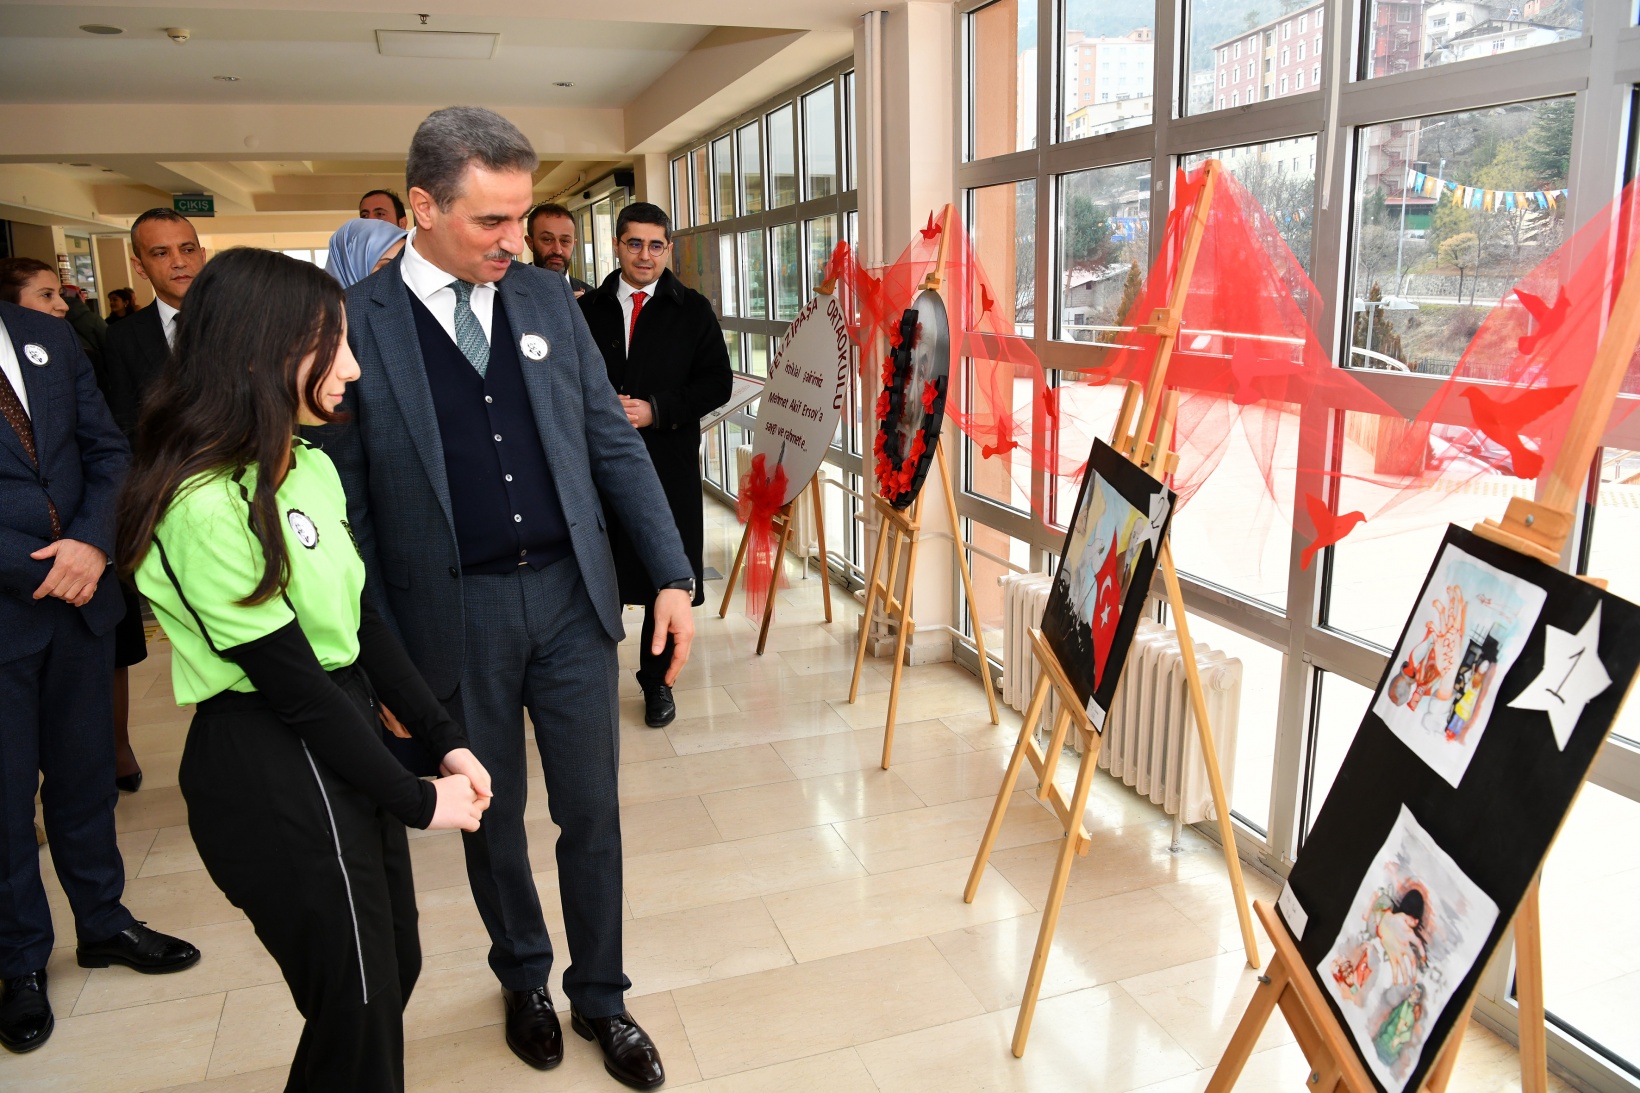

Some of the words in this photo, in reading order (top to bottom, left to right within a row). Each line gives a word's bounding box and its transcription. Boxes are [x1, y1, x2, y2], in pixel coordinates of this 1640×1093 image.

[179, 200, 209, 211] ÇIKIŞ
[827, 299, 848, 410] ORTAOKULU
[802, 370, 823, 388] şairimiz
[768, 391, 789, 409] Mehmet
[789, 399, 802, 414] Akif
[801, 404, 824, 422] Ersoy'a
[777, 427, 785, 438] ve
[1150, 496, 1165, 529] 2
[1545, 646, 1586, 705] 1
